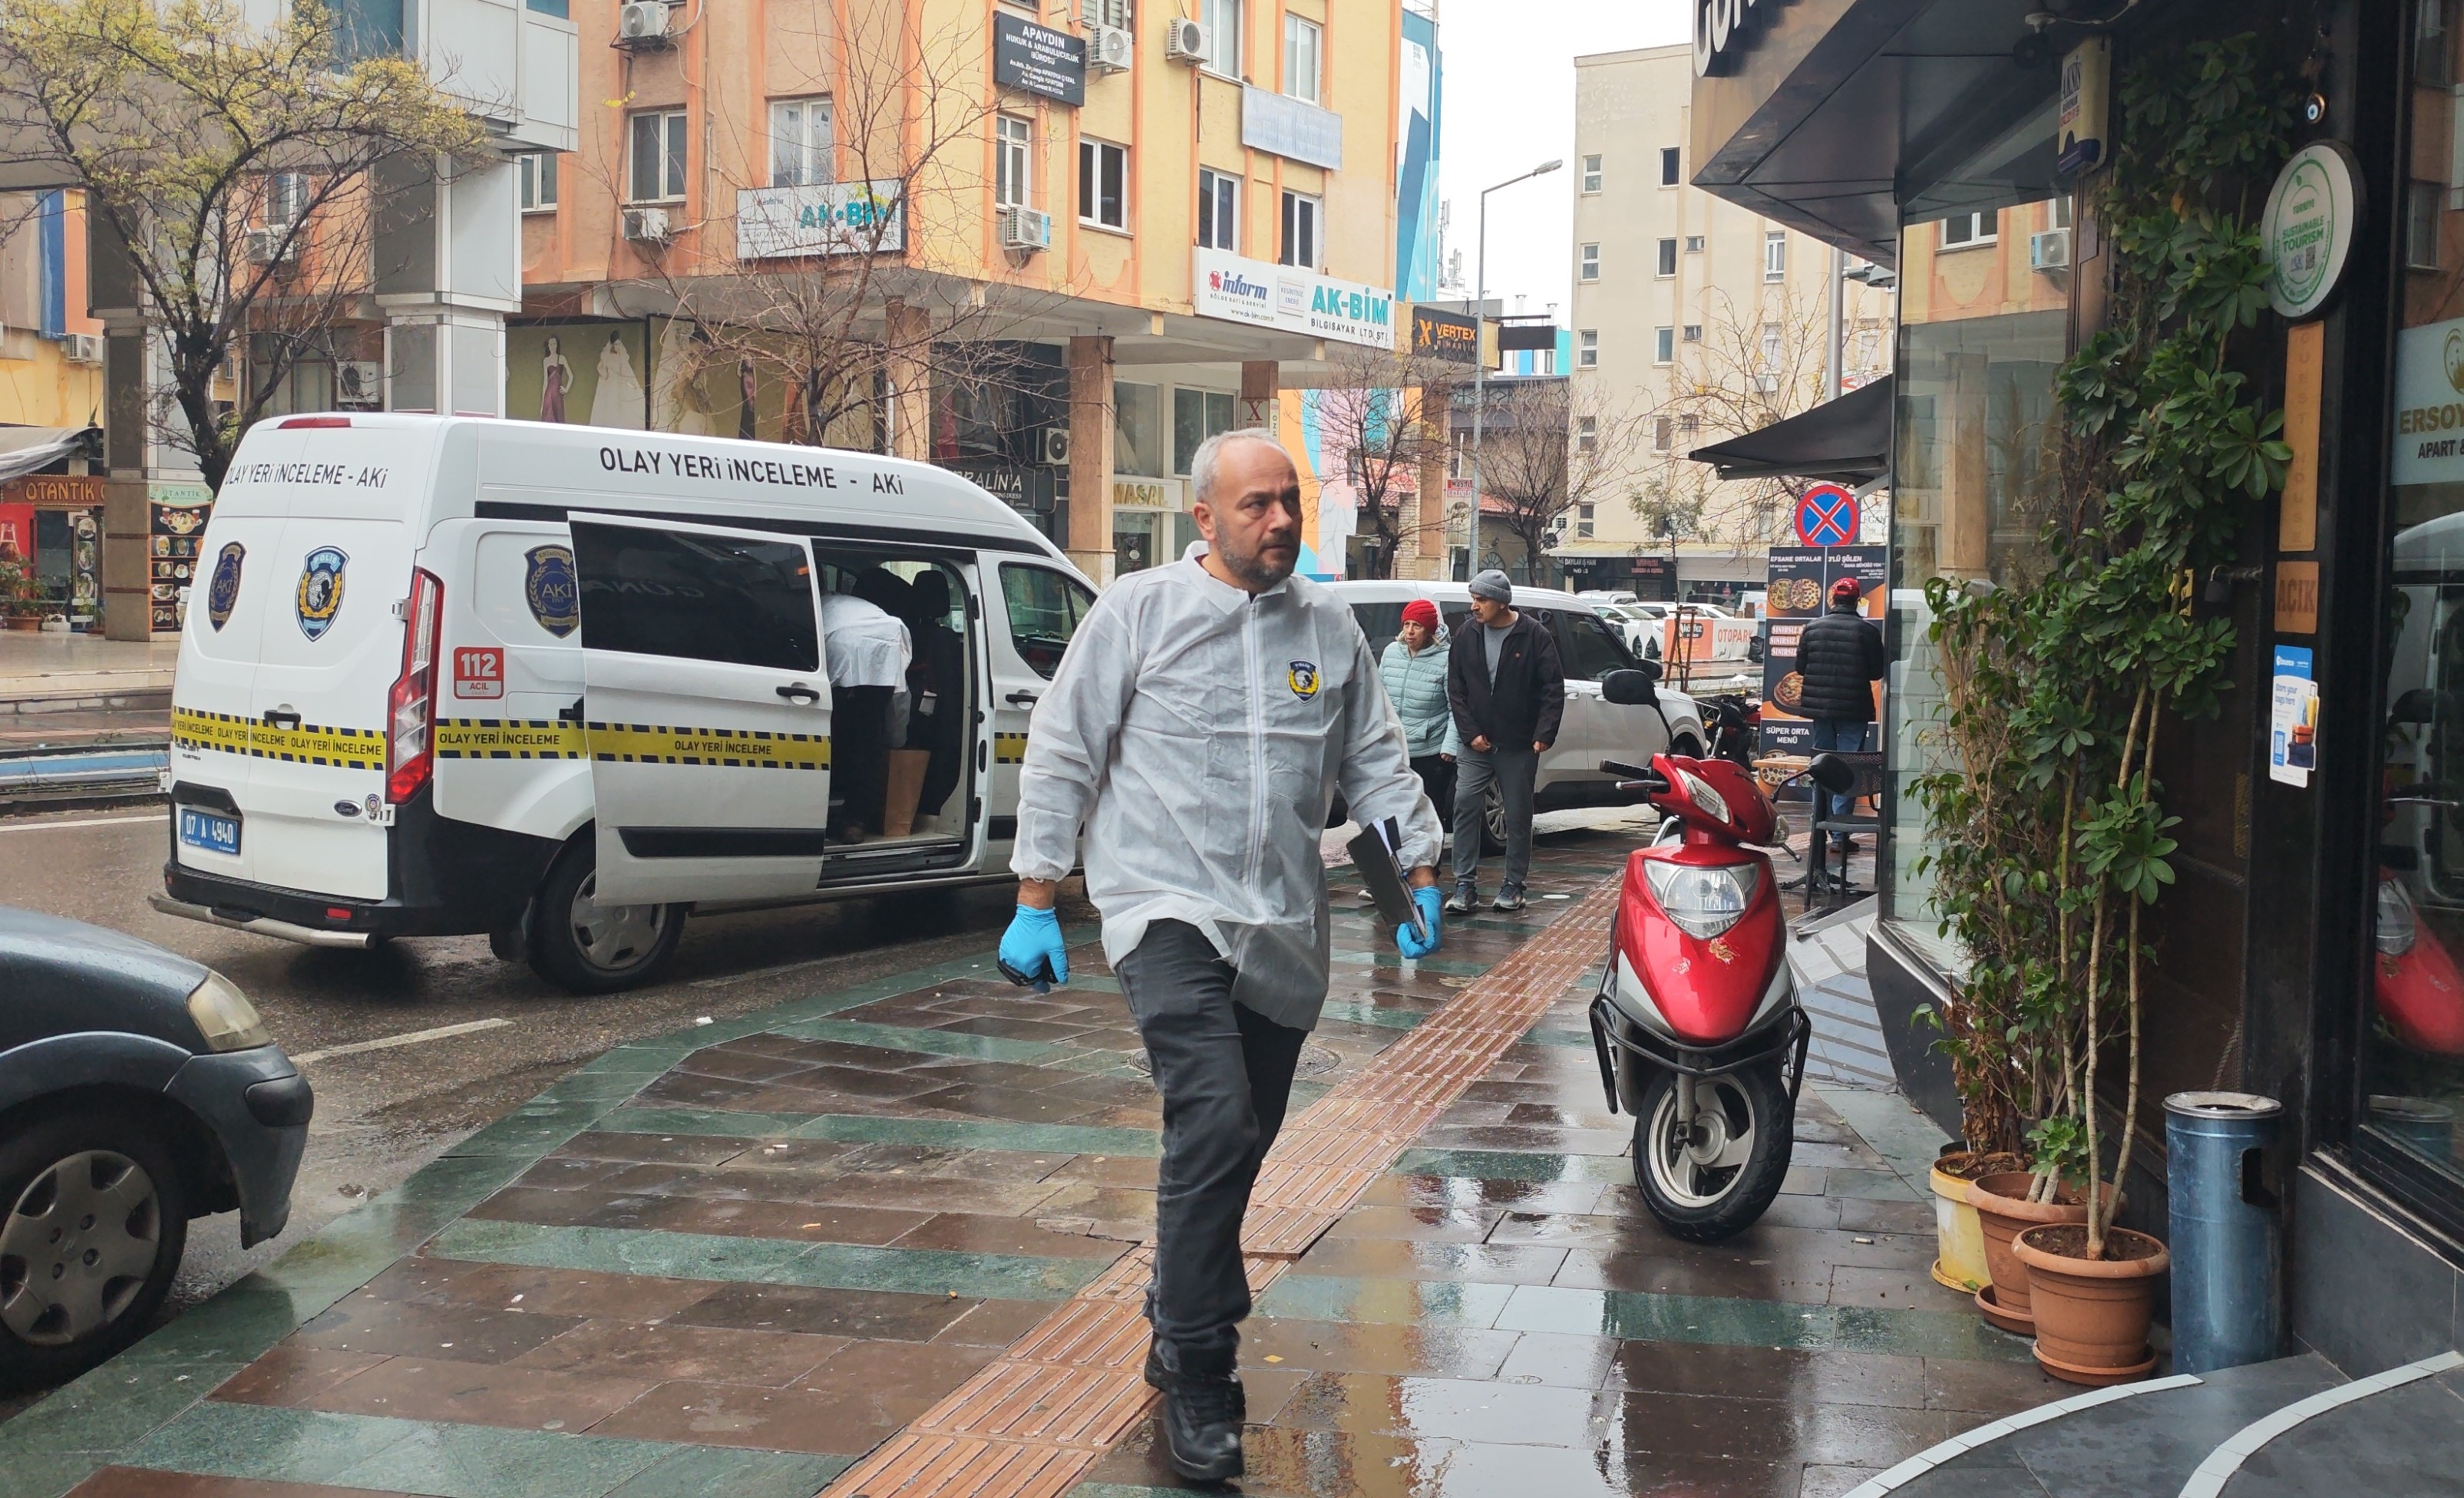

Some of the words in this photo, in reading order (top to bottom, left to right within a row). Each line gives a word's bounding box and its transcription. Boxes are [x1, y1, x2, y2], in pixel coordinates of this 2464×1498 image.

[1006, 33, 1027, 47] HUKUK
[1022, 25, 1065, 49] APAYDIN
[2282, 215, 2324, 239] SUSTAINABLE
[2283, 227, 2324, 253] TOURISM
[1222, 271, 1267, 300] inform
[1310, 285, 1389, 326] AK-BİM
[1359, 327, 1373, 339] LTD
[1435, 322, 1476, 341] VERTEX
[2297, 332, 2310, 425] GUEST
[2418, 439, 2456, 459] APART
[599, 447, 662, 474] OLAY
[226, 464, 249, 485] OLAY
[25, 477, 95, 500] OTANTİK
[162, 489, 201, 497] OTANTİK
[1841, 554, 1862, 563] ŞÖLEN
[541, 581, 573, 598] AKİ
[2277, 579, 2317, 622] AÇIK
[1683, 624, 1703, 632] köfez
[1718, 629, 1753, 643] OTOPARK
[461, 652, 497, 677] 112
[439, 732, 471, 744] OLAY
[474, 731, 500, 744] YERİ
[502, 731, 560, 745] İNCELEME
[1765, 726, 1789, 735] SÜPER
[1791, 728, 1810, 736] ORTA
[217, 728, 233, 739] OLAY
[291, 737, 311, 750] OLAY
[312, 738, 331, 751] YERİ
[332, 739, 382, 756] İNCELEME
[675, 740, 700, 751] OLAY
[702, 740, 723, 752] YERİ
[725, 740, 772, 754] İNCELEME
[186, 814, 197, 836] 07
[201, 817, 206, 839] A
[212, 820, 233, 844] 4940
